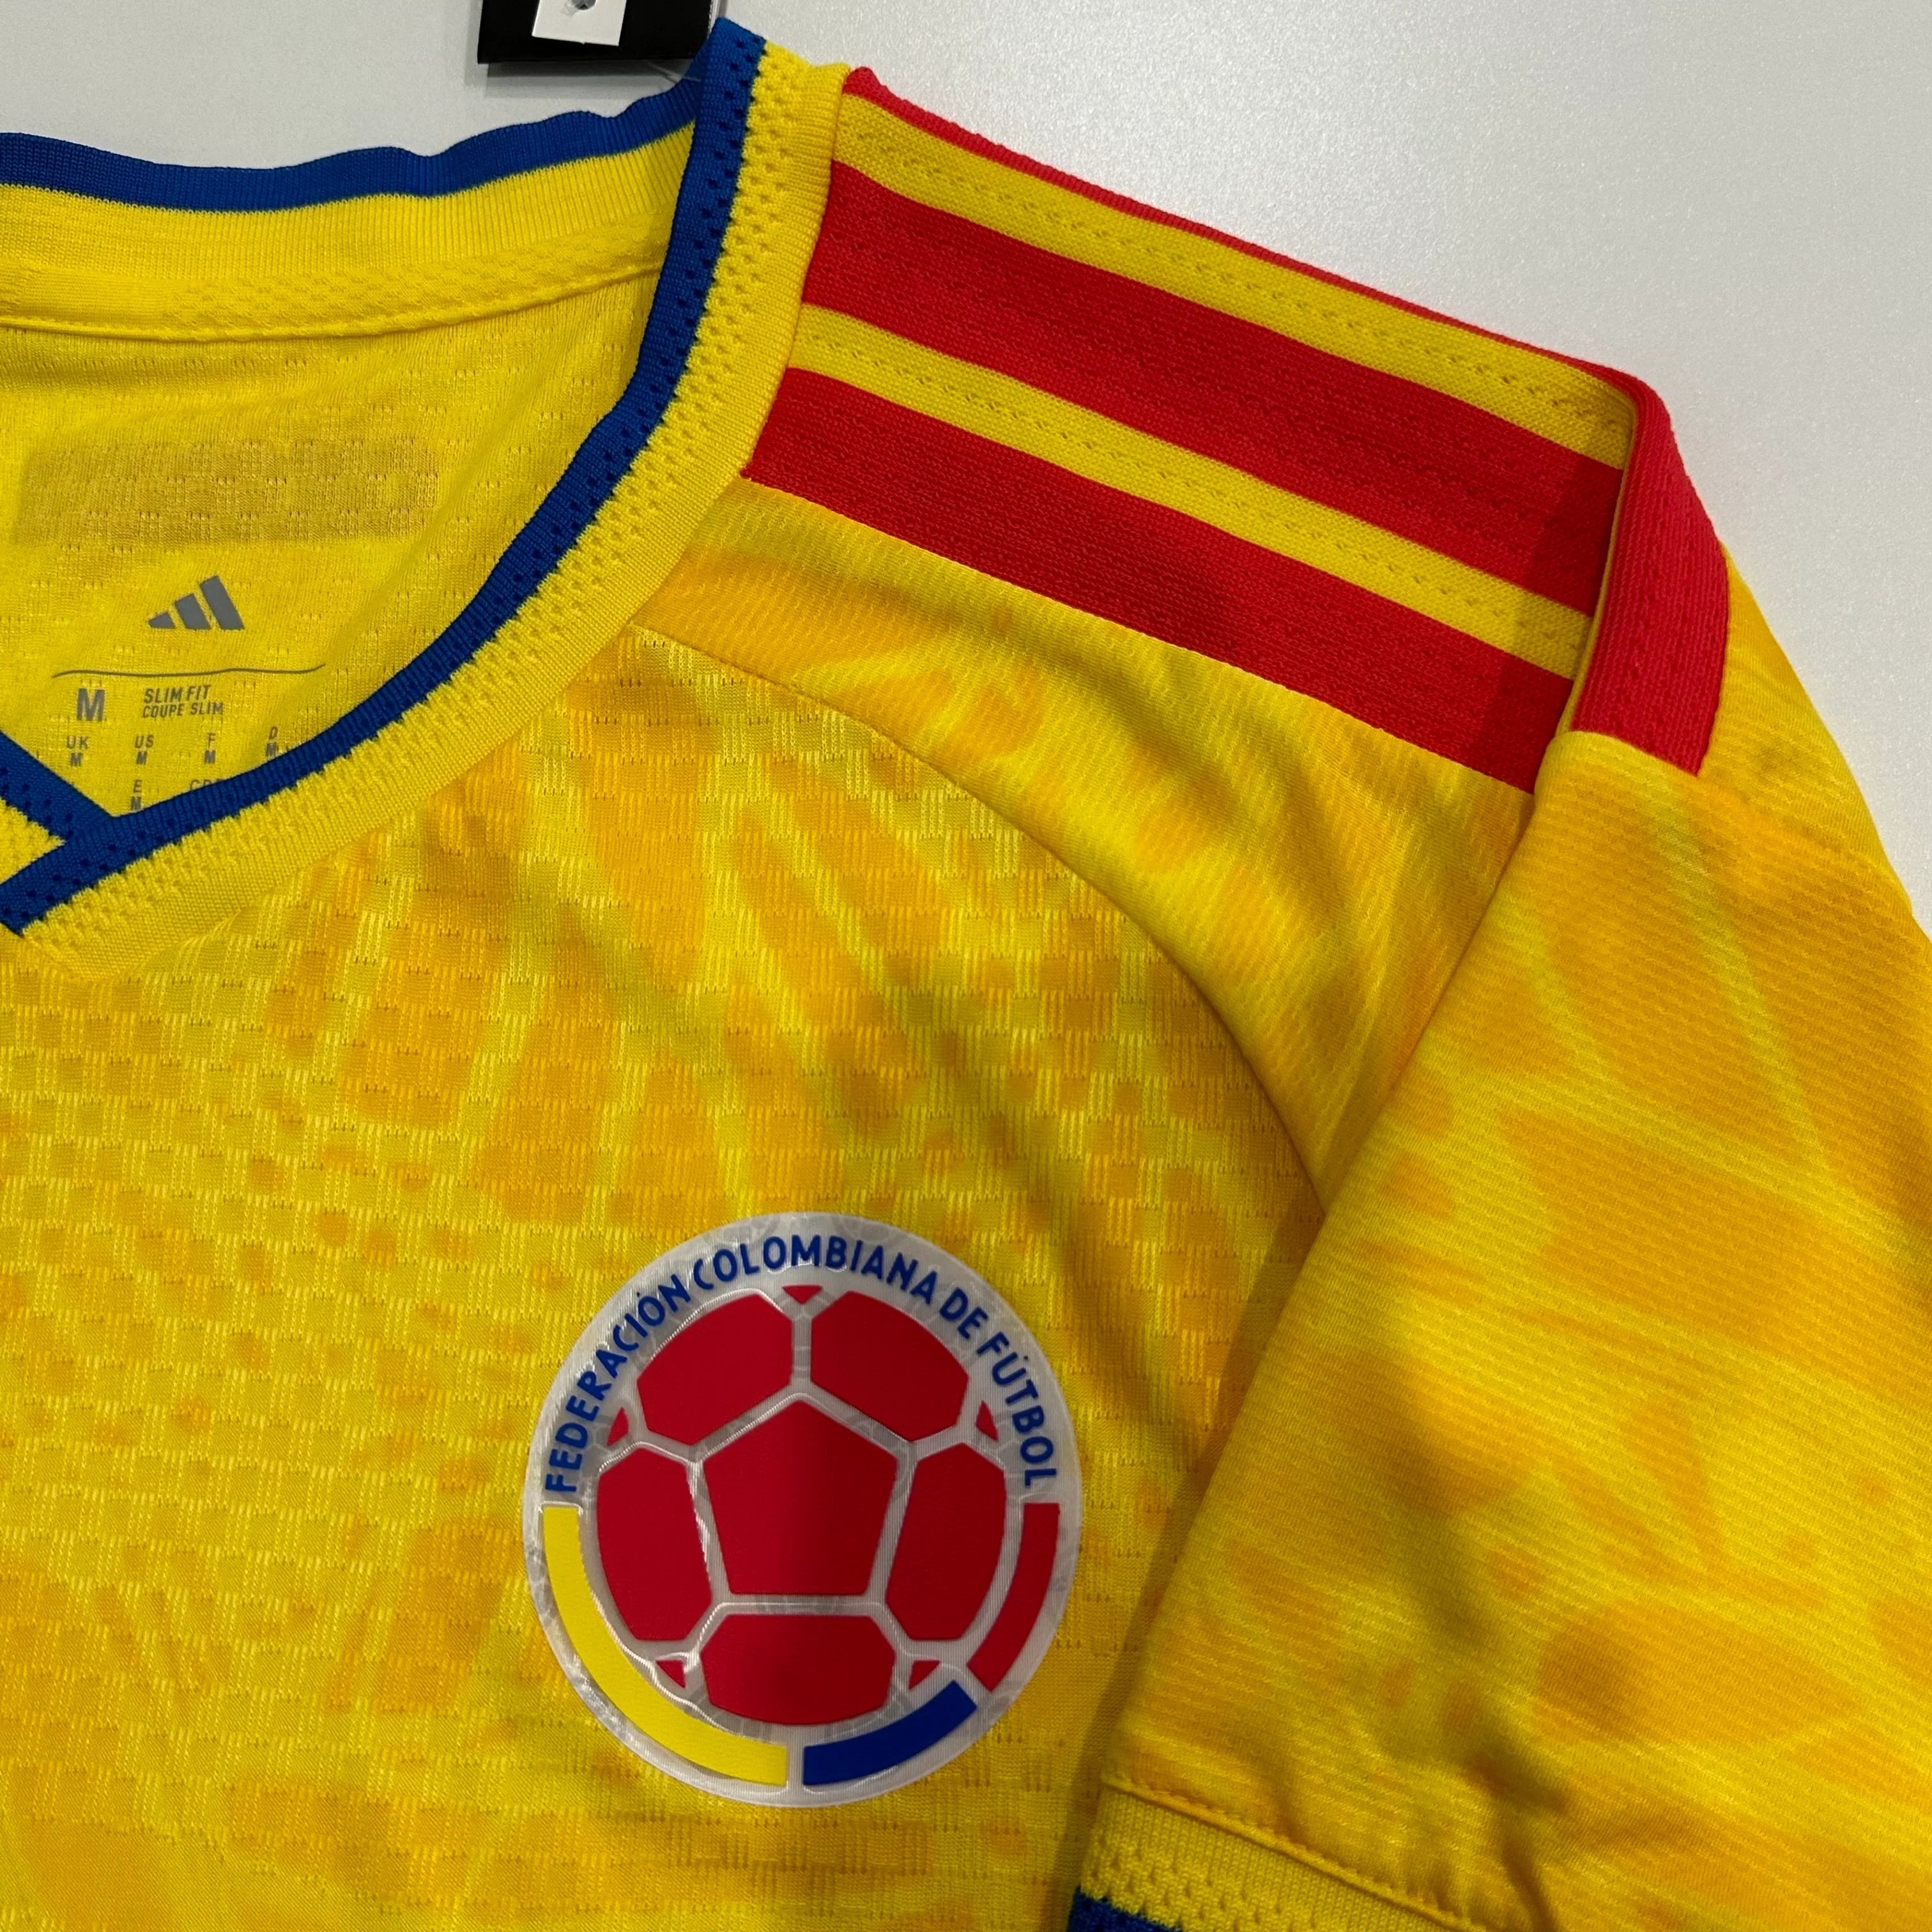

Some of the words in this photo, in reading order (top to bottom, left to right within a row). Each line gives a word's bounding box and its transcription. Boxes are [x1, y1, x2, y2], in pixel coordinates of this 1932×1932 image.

[144, 687, 183, 703] SLIM
[186, 684, 211, 702] FIT
[77, 688, 105, 722] M
[142, 703, 184, 718] COUPE
[190, 700, 223, 715] SLIM
[66, 736, 89, 749] UK
[135, 735, 154, 749] US
[208, 732, 216, 749] F
[269, 726, 279, 740] D
[70, 753, 83, 767] M
[136, 751, 148, 765] M
[204, 749, 216, 764] M
[133, 779, 142, 793] E
[692, 1234, 939, 1305] COLOMBIANA
[939, 1287, 989, 1340] DE
[976, 1331, 1057, 1487] FÚTBOL
